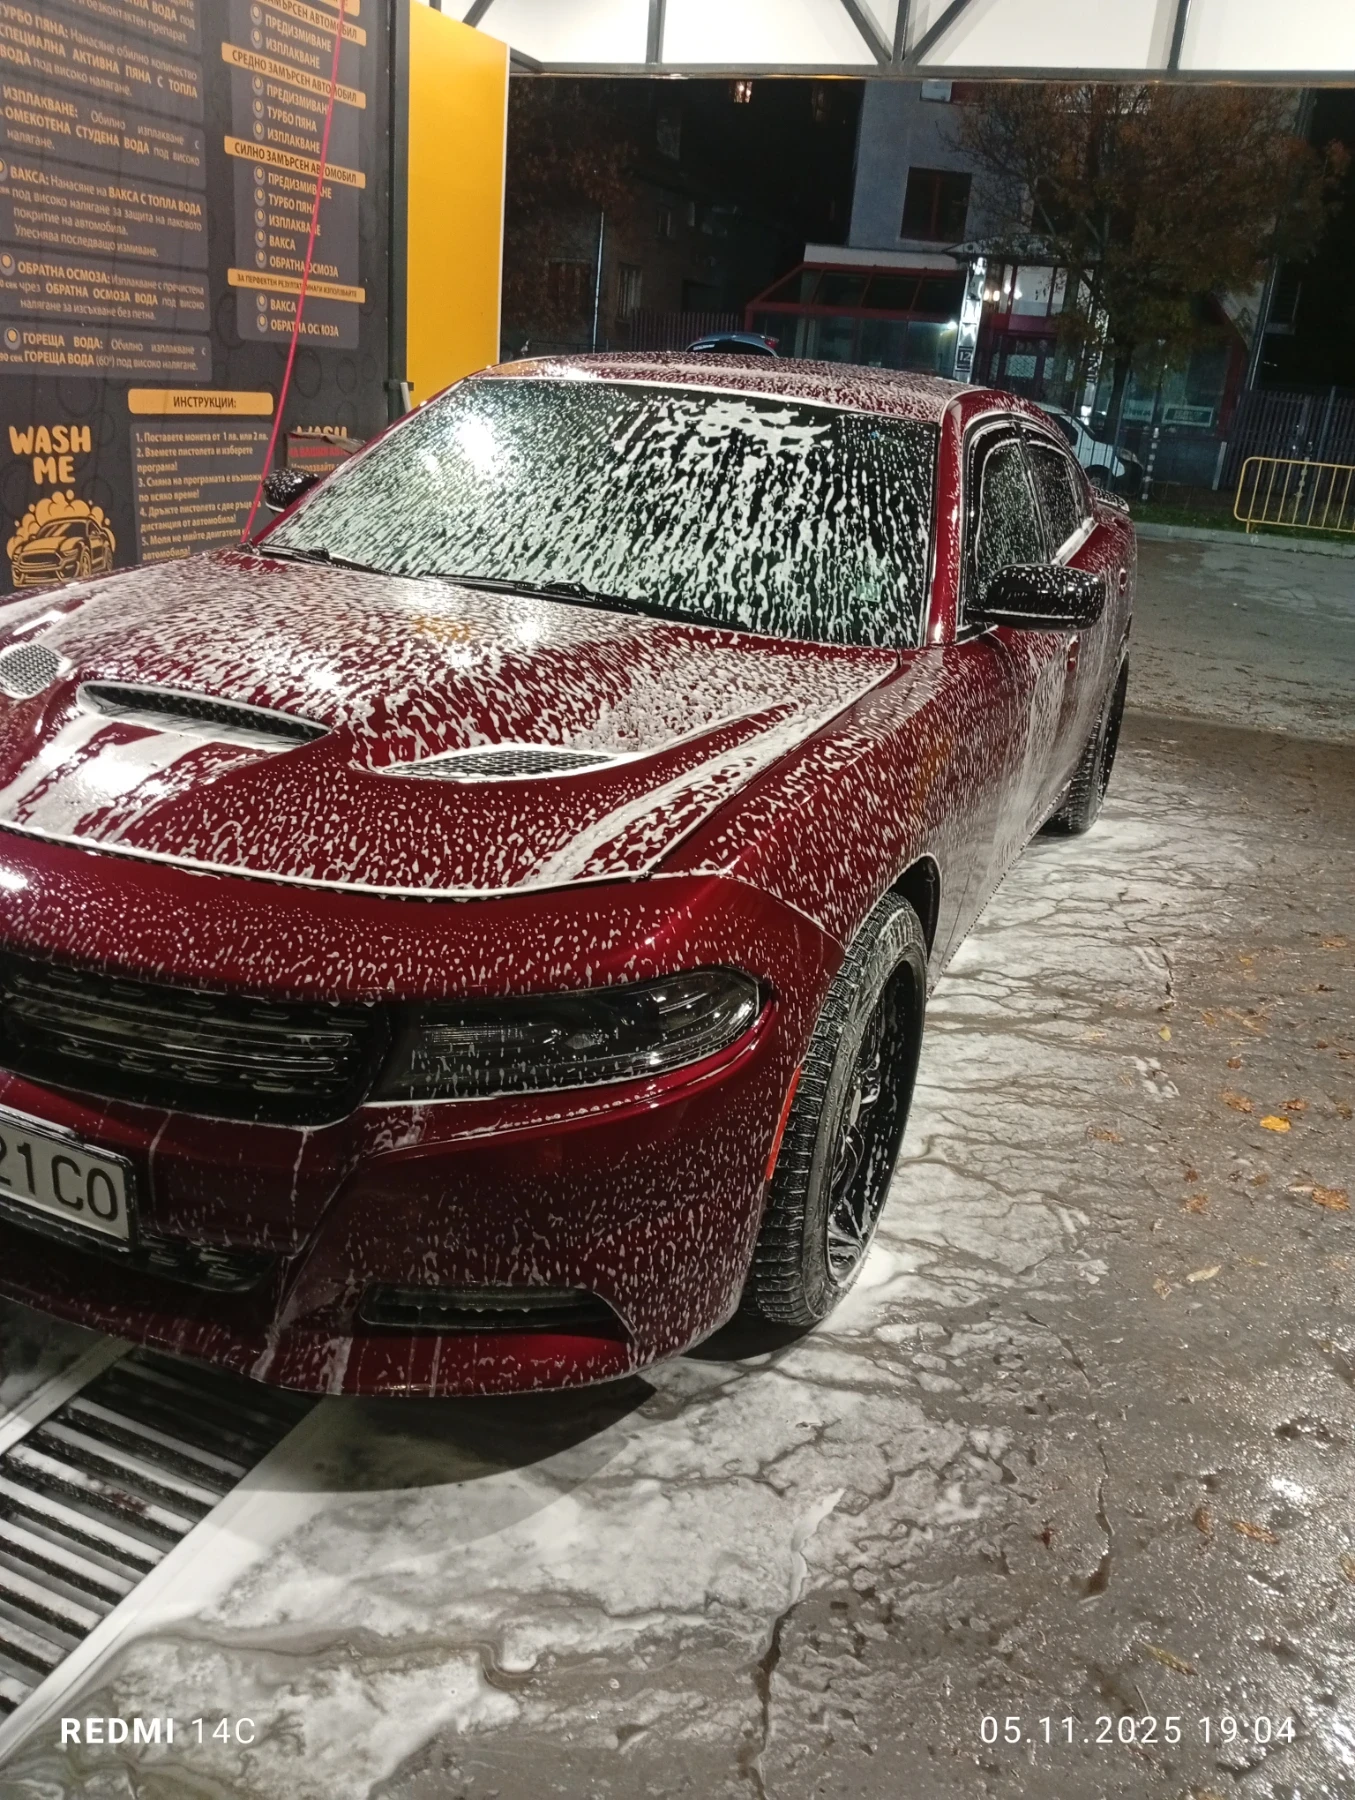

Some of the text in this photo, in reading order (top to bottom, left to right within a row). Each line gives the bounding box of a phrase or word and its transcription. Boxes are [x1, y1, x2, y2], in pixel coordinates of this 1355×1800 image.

[152, 1, 177, 21] ВОДА
[0, 1, 32, 26] УРБО
[35, 14, 69, 39] ПЯНА:
[117, 45, 149, 66] обилно
[150, 58, 197, 80] количество
[265, 14, 331, 52] ПРЕДИЗМИВАНЕ
[0, 22, 66, 58] СПЕЦИАЛНА
[72, 48, 120, 75] АКТИВНА
[125, 64, 152, 84] ПЯНА
[168, 79, 198, 98] ТОПЛА
[266, 37, 320, 69] ИЗПЛАКВАНЕ
[0, 43, 132, 97] ВОДА под високо налягане.
[232, 50, 267, 71] СРЕДНО
[268, 63, 311, 87] ЗАМЪРСЕН
[3, 84, 78, 118] ИЗПЛАКВАНЕ:
[90, 110, 126, 131] Обилно
[137, 125, 184, 145] изплакване
[267, 106, 317, 132] ТУРБО ПЯНА
[5, 105, 71, 135] ОМЕКОТЕНА
[75, 125, 119, 147] СТУДЕНА
[124, 136, 150, 155] ВОДА
[153, 147, 169, 160] под
[172, 151, 200, 166] високо
[7, 129, 55, 150] налягане.
[267, 127, 320, 154] ИЗПЛАКВАНЕ
[234, 141, 264, 160] СИЛНО
[267, 149, 309, 173] ЗАМЪРСЕН
[10, 165, 49, 185] ВАКСА:
[50, 174, 95, 195] Нанасяне
[96, 187, 107, 197] на
[108, 186, 139, 203] ВАКСА
[147, 194, 177, 210] ТОПЛА
[178, 200, 201, 216] ВОДА
[268, 193, 295, 211] ТУРБО
[12, 188, 31, 203] под
[34, 191, 67, 207] високо
[70, 199, 110, 215] налягане
[113, 206, 121, 217] за
[124, 209, 153, 223] защита
[155, 215, 165, 225] на
[167, 217, 202, 232] лаковото
[14, 207, 128, 235] покритие на автомобила.
[269, 214, 321, 236] ИЗПЛАКВАЕ
[14, 223, 59, 241] Улеснява
[60, 233, 116, 251] последващо
[269, 235, 296, 250] ВАКСА
[18, 261, 65, 279] ОБРАТНА
[66, 268, 110, 284] ОСМОЗА:
[20, 282, 205, 310] чрез ОБРАТНА ОСМОЗА ВОДА под високо
[270, 299, 297, 313] ВАКСА
[20, 299, 61, 312] налягане
[63, 304, 72, 313] за
[73, 304, 116, 317] изсъхване
[117, 307, 131, 318] без
[23, 332, 65, 347] ГОРЕЩА
[73, 336, 103, 350] ВОДА:
[111, 339, 143, 352] Обилно
[151, 343, 195, 355] изплакване
[24, 350, 66, 366] ГОРЕЩА
[67, 352, 94, 366] ВОДА
[116, 359, 132, 369] под
[133, 359, 161, 368] високо
[173, 396, 237, 410] ИНСТРУКЦИИ:
[9, 425, 91, 455] WASH
[136, 433, 143, 442] 1.
[144, 432, 184, 442] Поставете
[185, 433, 211, 442] монета
[212, 433, 220, 441] от
[136, 448, 144, 457] 2.
[145, 447, 177, 457] Вземете
[178, 447, 215, 456] пистолета
[222, 445, 253, 456] изберете
[33, 455, 76, 485] ME
[137, 461, 178, 474] програма!
[138, 478, 146, 487] 3.
[173, 477, 182, 485] на
[183, 475, 225, 487] програмата
[139, 494, 149, 502] по
[180, 503, 215, 513] пистолета
[140, 514, 236, 533] дистанция от автомобила!
[150, 535, 171, 545] Моля
